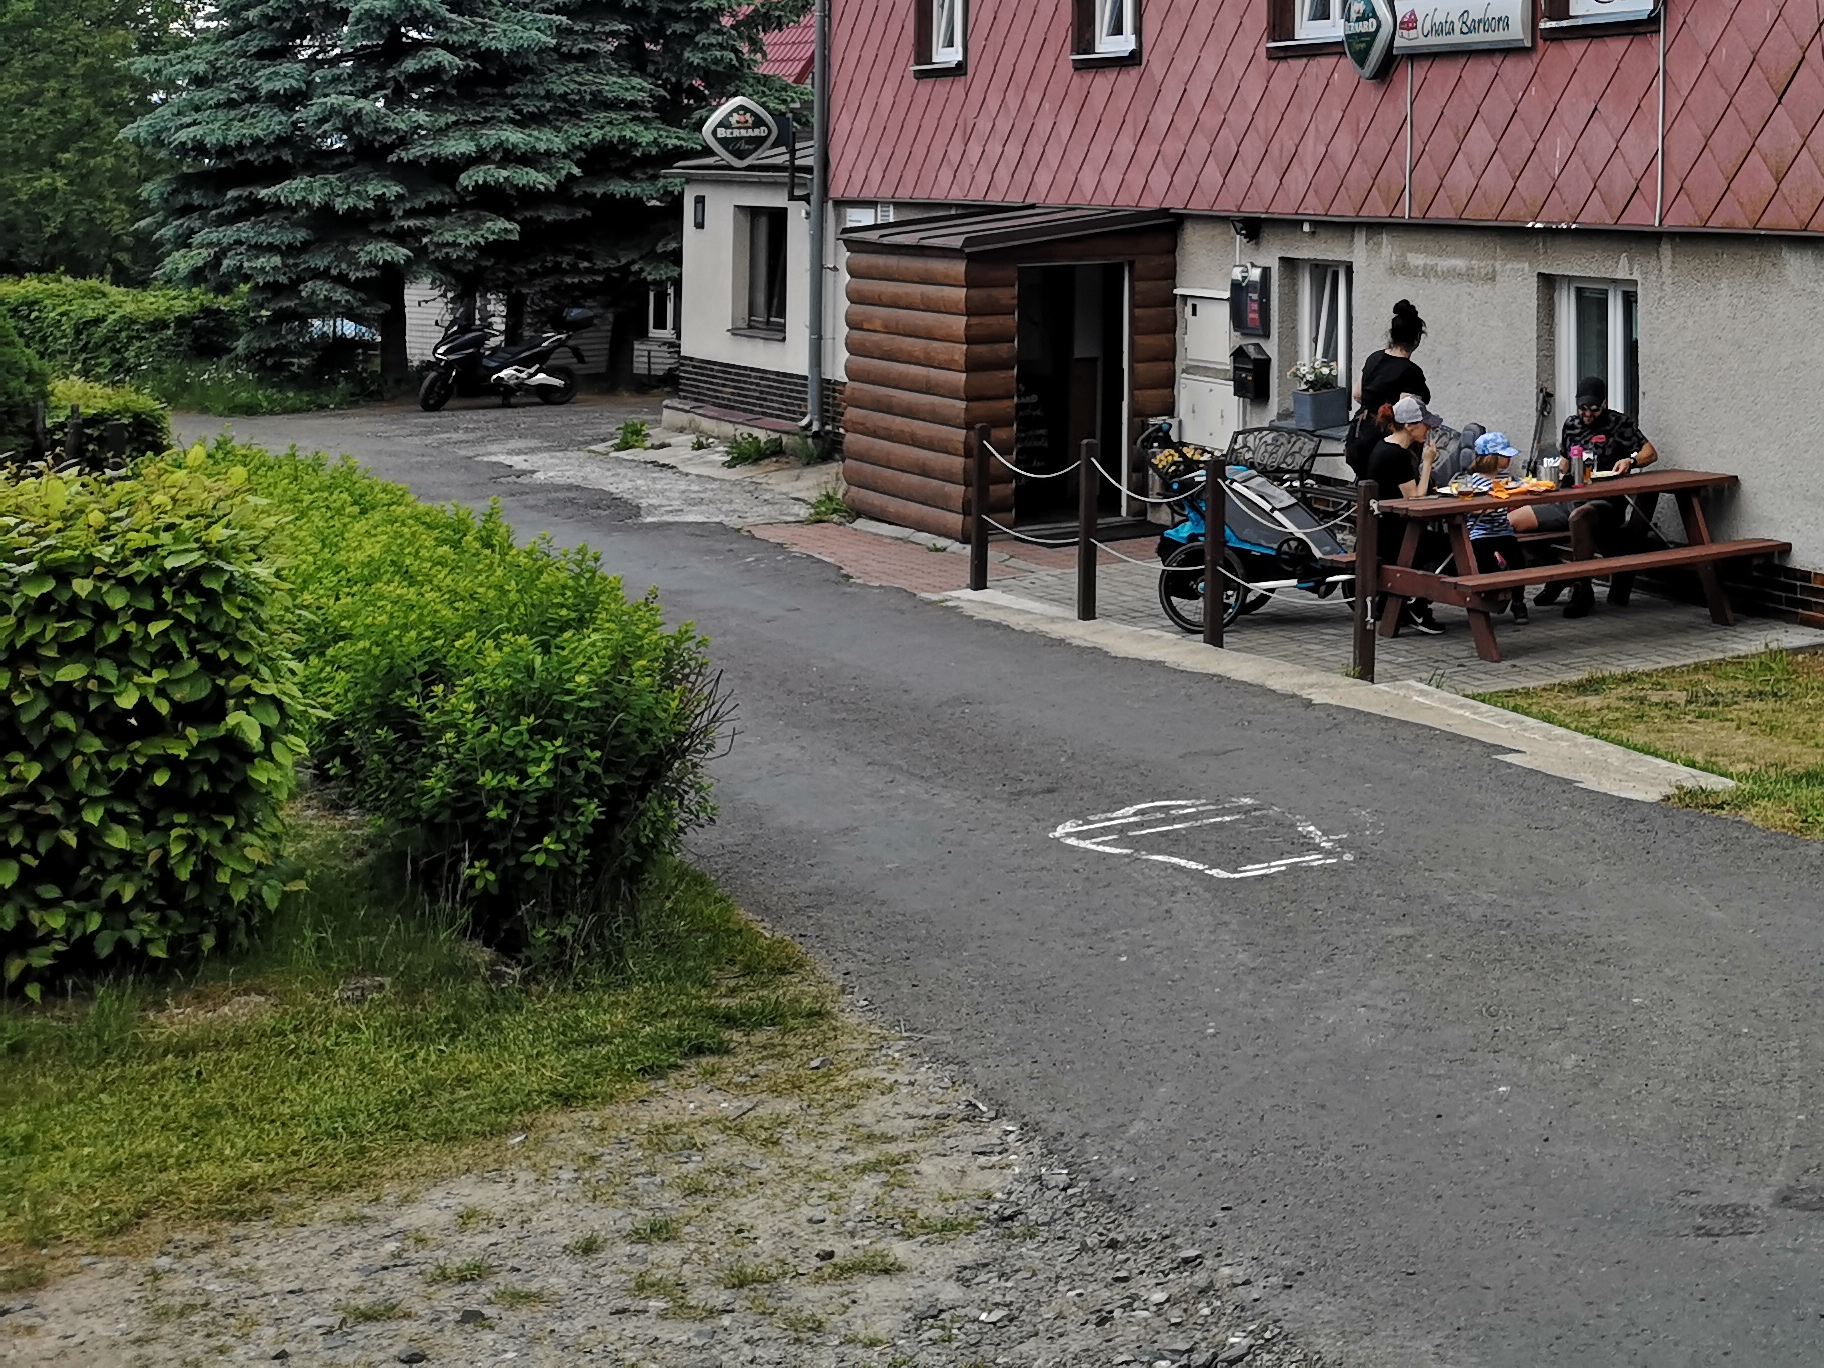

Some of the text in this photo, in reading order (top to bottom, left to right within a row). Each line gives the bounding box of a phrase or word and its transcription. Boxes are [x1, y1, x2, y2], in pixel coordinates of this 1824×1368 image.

[1421, 2, 1510, 38] Chata Barbora
[717, 126, 768, 138] BERNARD
